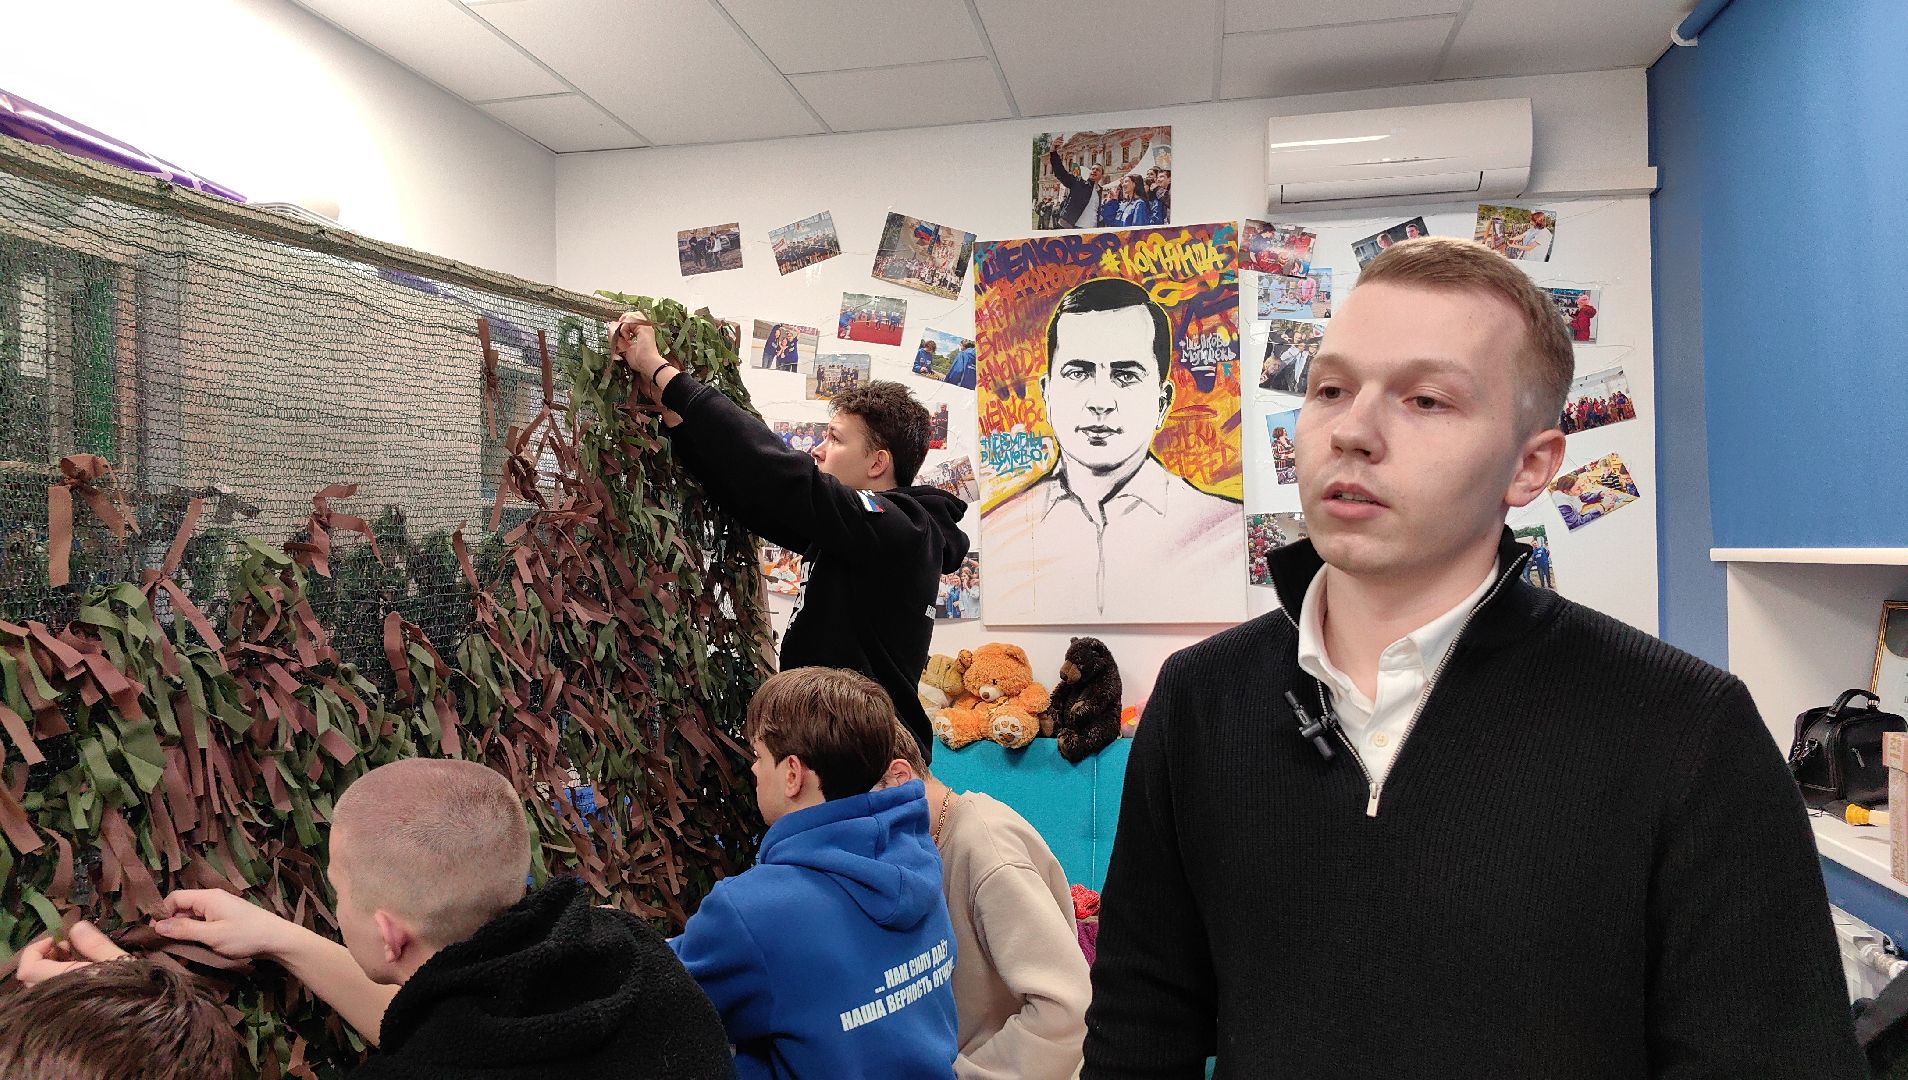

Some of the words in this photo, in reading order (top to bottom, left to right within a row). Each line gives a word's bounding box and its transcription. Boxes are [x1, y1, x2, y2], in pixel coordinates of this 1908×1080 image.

[884, 963, 910, 989] НАМ
[909, 951, 931, 977] СИЛУ
[840, 998, 887, 1031] НАША
[886, 976, 932, 1013] ВЕРНОСТЬ
